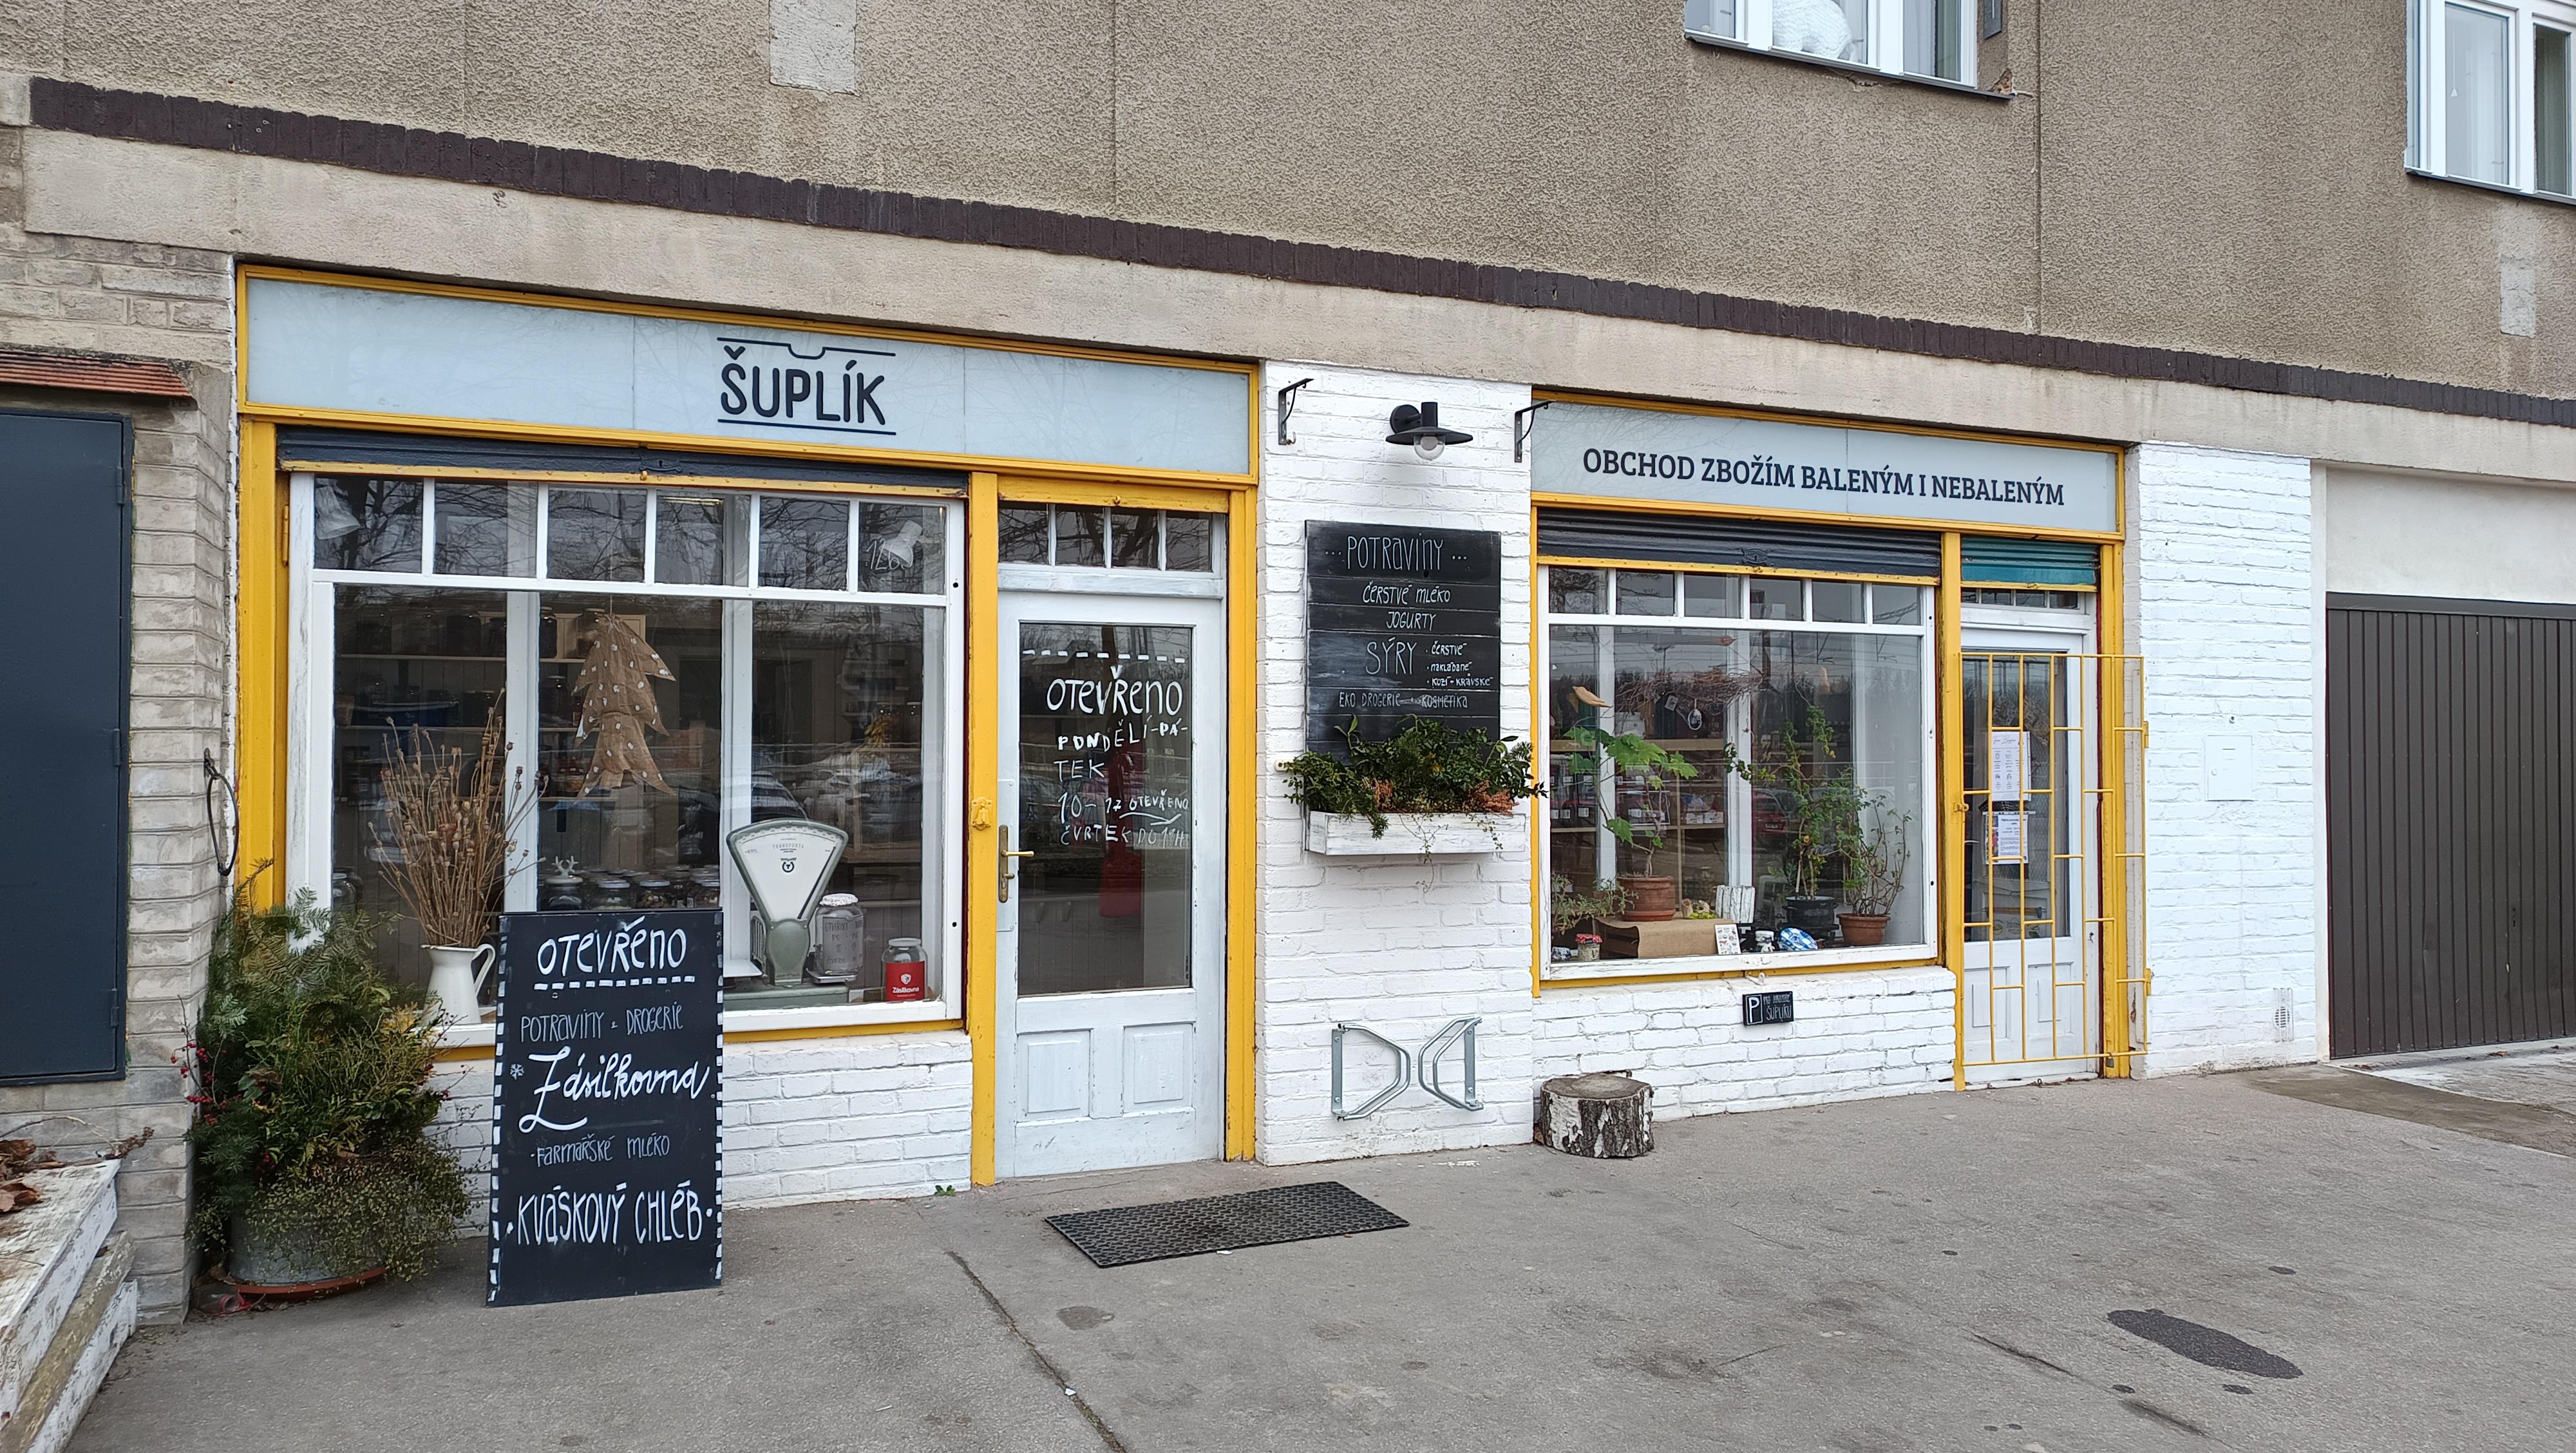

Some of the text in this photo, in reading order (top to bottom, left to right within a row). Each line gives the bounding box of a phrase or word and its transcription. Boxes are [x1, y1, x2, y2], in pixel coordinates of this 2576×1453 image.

[721, 345, 886, 425] ŠUPLÍK
[1584, 448, 2065, 506] OBCHOD ZBOŽÍM BALENÝM I NEBALENÝM
[1347, 535, 1444, 571] POTRAVINY
[1363, 581, 1450, 605] ČERSTVÉ MLÉKO
[1386, 611, 1436, 631] JOGURTY
[1365, 637, 1417, 675] SÝRY
[1431, 640, 1467, 656] ČERSTVÉ
[1046, 665, 1183, 716] OTEVŘENO
[1339, 692, 1468, 708] EKO DROGERIE KOSMETIKA
[1054, 759, 1104, 783] TEK
[1129, 788, 1189, 811] OTEVŘENO
[1061, 824, 1132, 846] ČVRTEK
[1138, 828, 1157, 844] DO
[537, 915, 687, 976] OTEVŘENO
[520, 1009, 605, 1043] POTRAVINY
[626, 1001, 684, 1036] DROGERIE
[1748, 996, 1760, 1023] P
[536, 1132, 670, 1168] FARMÁŘSKÉ MLÉKO
[518, 1180, 703, 1246] KVÁSKOVÝ CHLÉB
